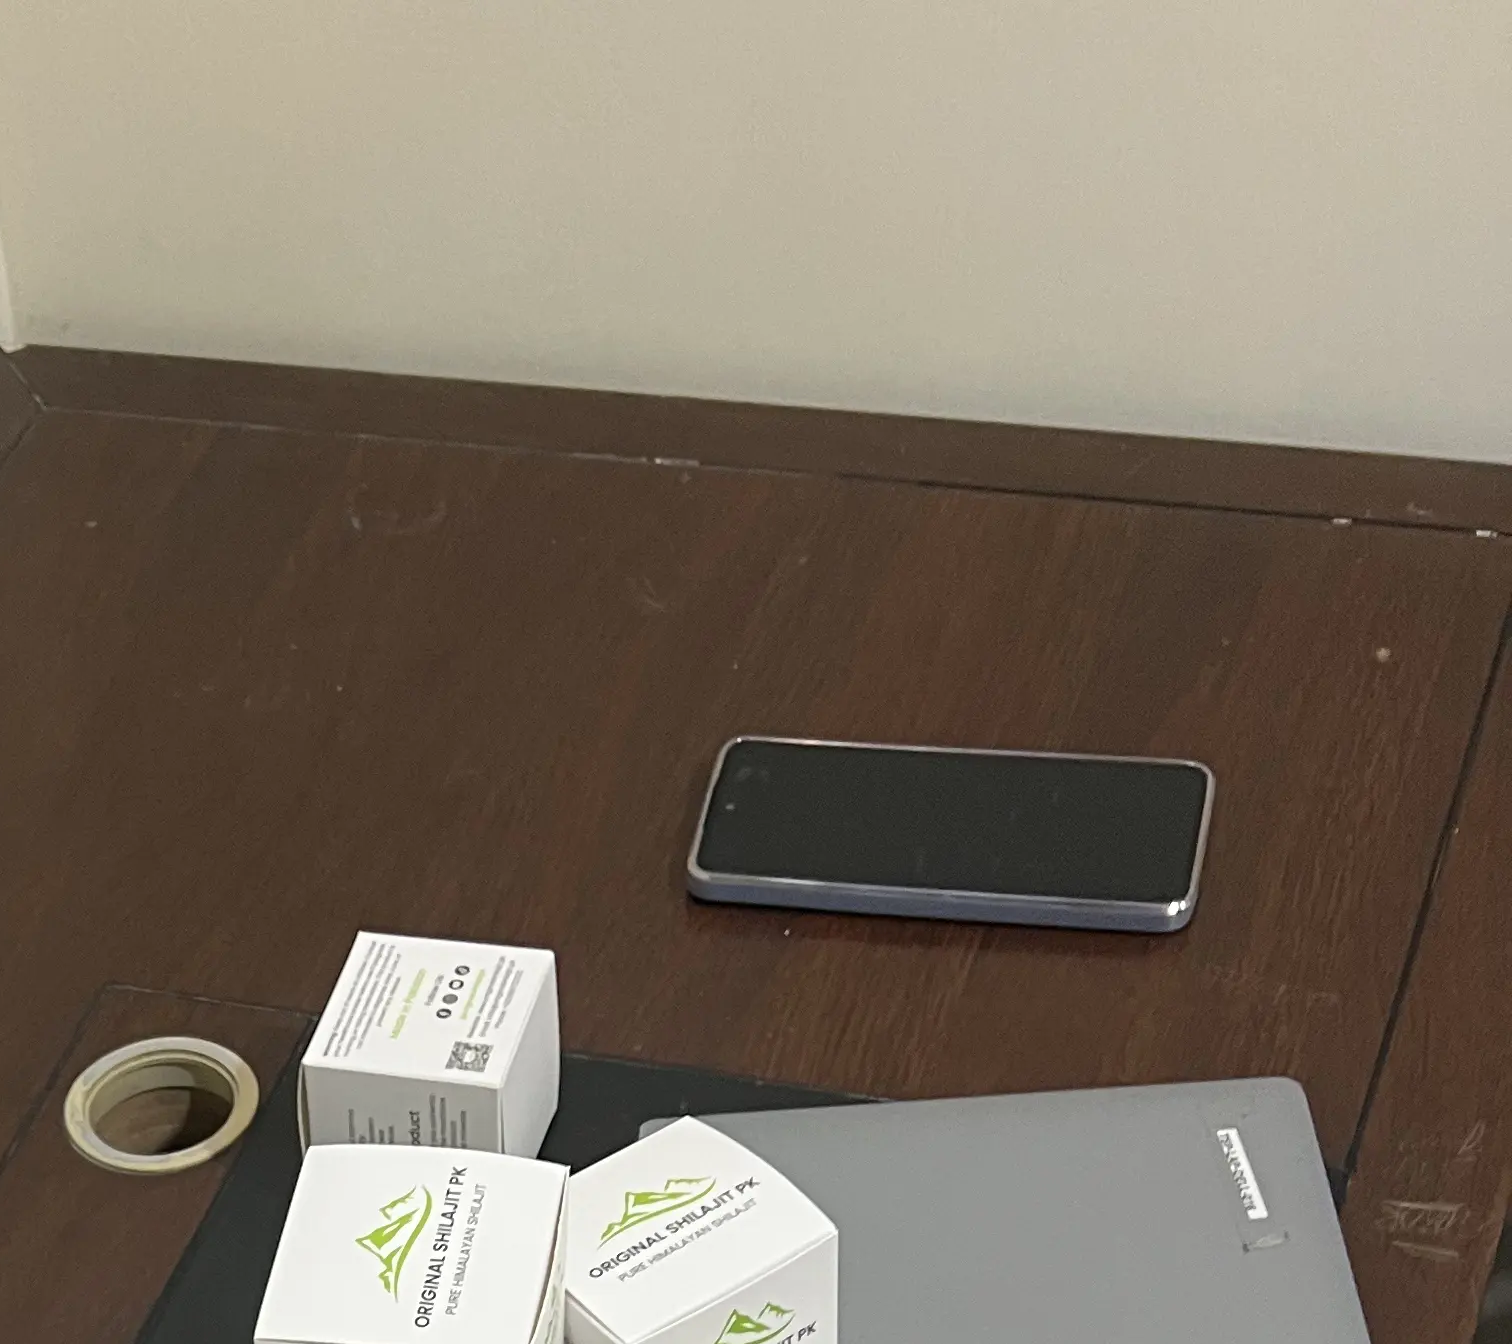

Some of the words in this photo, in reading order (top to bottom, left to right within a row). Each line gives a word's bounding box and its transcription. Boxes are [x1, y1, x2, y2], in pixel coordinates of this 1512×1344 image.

[414, 1256, 445, 1327] ORIGINAL
[432, 1188, 460, 1251] SHILAJIT
[449, 1167, 466, 1184] PK
[589, 1232, 667, 1277] ORIGINAL
[665, 1190, 733, 1233] SHILAJIT
[735, 1177, 759, 1193] PK
[797, 1321, 816, 1341] PK
